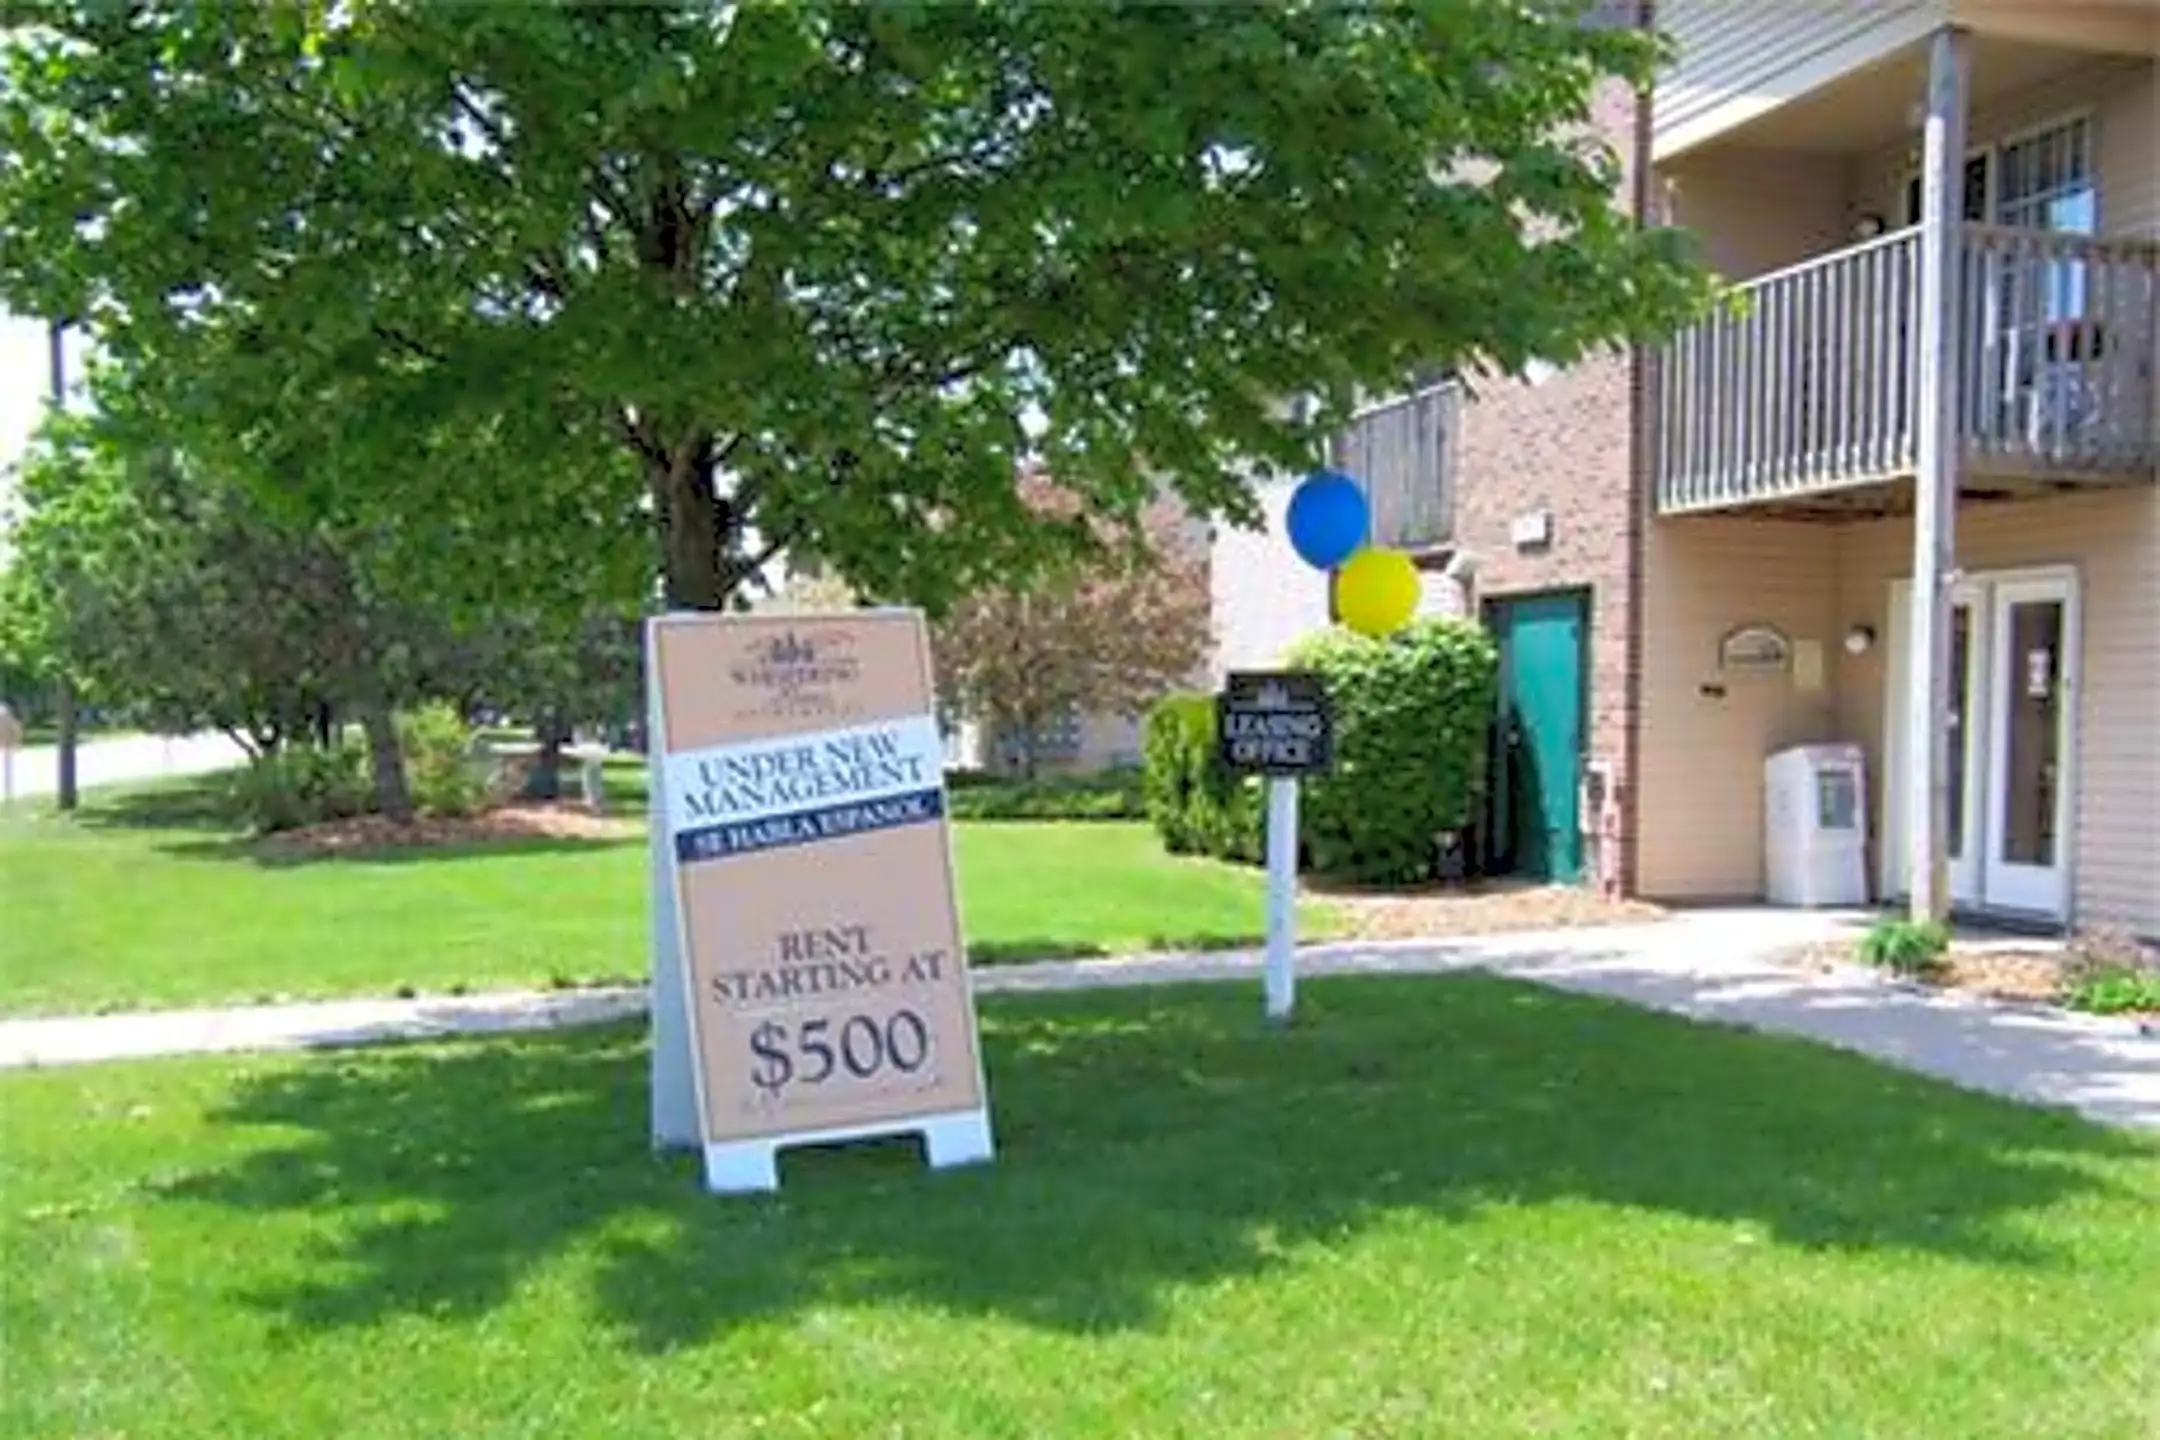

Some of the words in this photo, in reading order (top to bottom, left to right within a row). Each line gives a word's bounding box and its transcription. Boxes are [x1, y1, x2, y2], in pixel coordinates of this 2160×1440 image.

[684, 755, 923, 818] MANAGEMENT
[698, 747, 817, 787] UNDER
[823, 731, 898, 766] NEW
[779, 926, 871, 962] RENT
[711, 959, 890, 1004] STARTING
[902, 951, 946, 984] AT
[750, 1008, 929, 1097] $500
